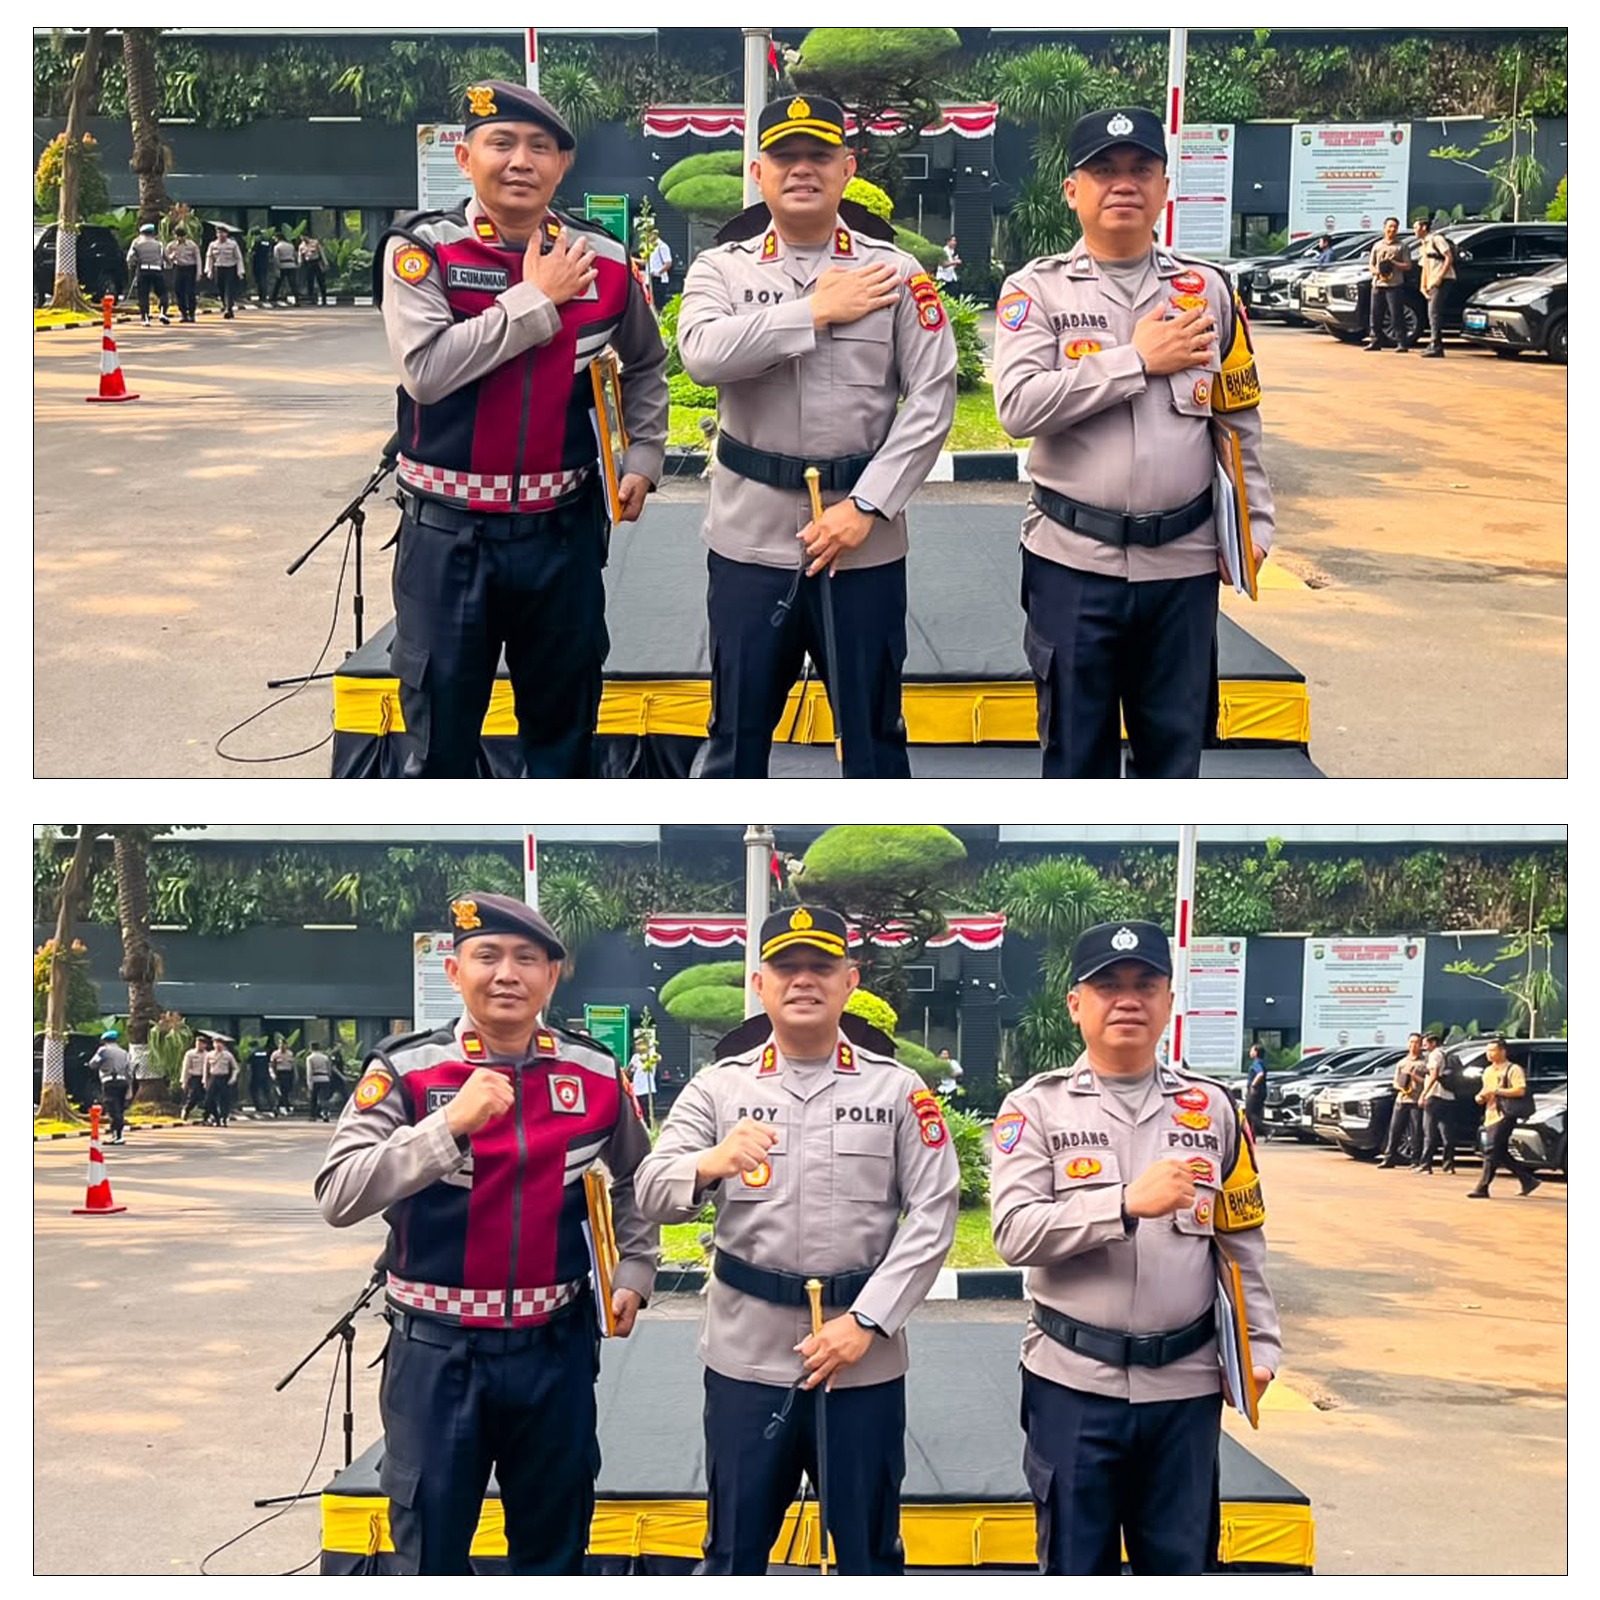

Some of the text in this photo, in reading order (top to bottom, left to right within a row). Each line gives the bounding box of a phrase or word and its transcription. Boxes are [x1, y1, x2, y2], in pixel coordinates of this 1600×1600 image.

[439, 131, 464, 142] AST
[744, 289, 783, 304] BOY
[835, 1106, 894, 1124] POLRI
[1168, 1131, 1218, 1151] POLRI
